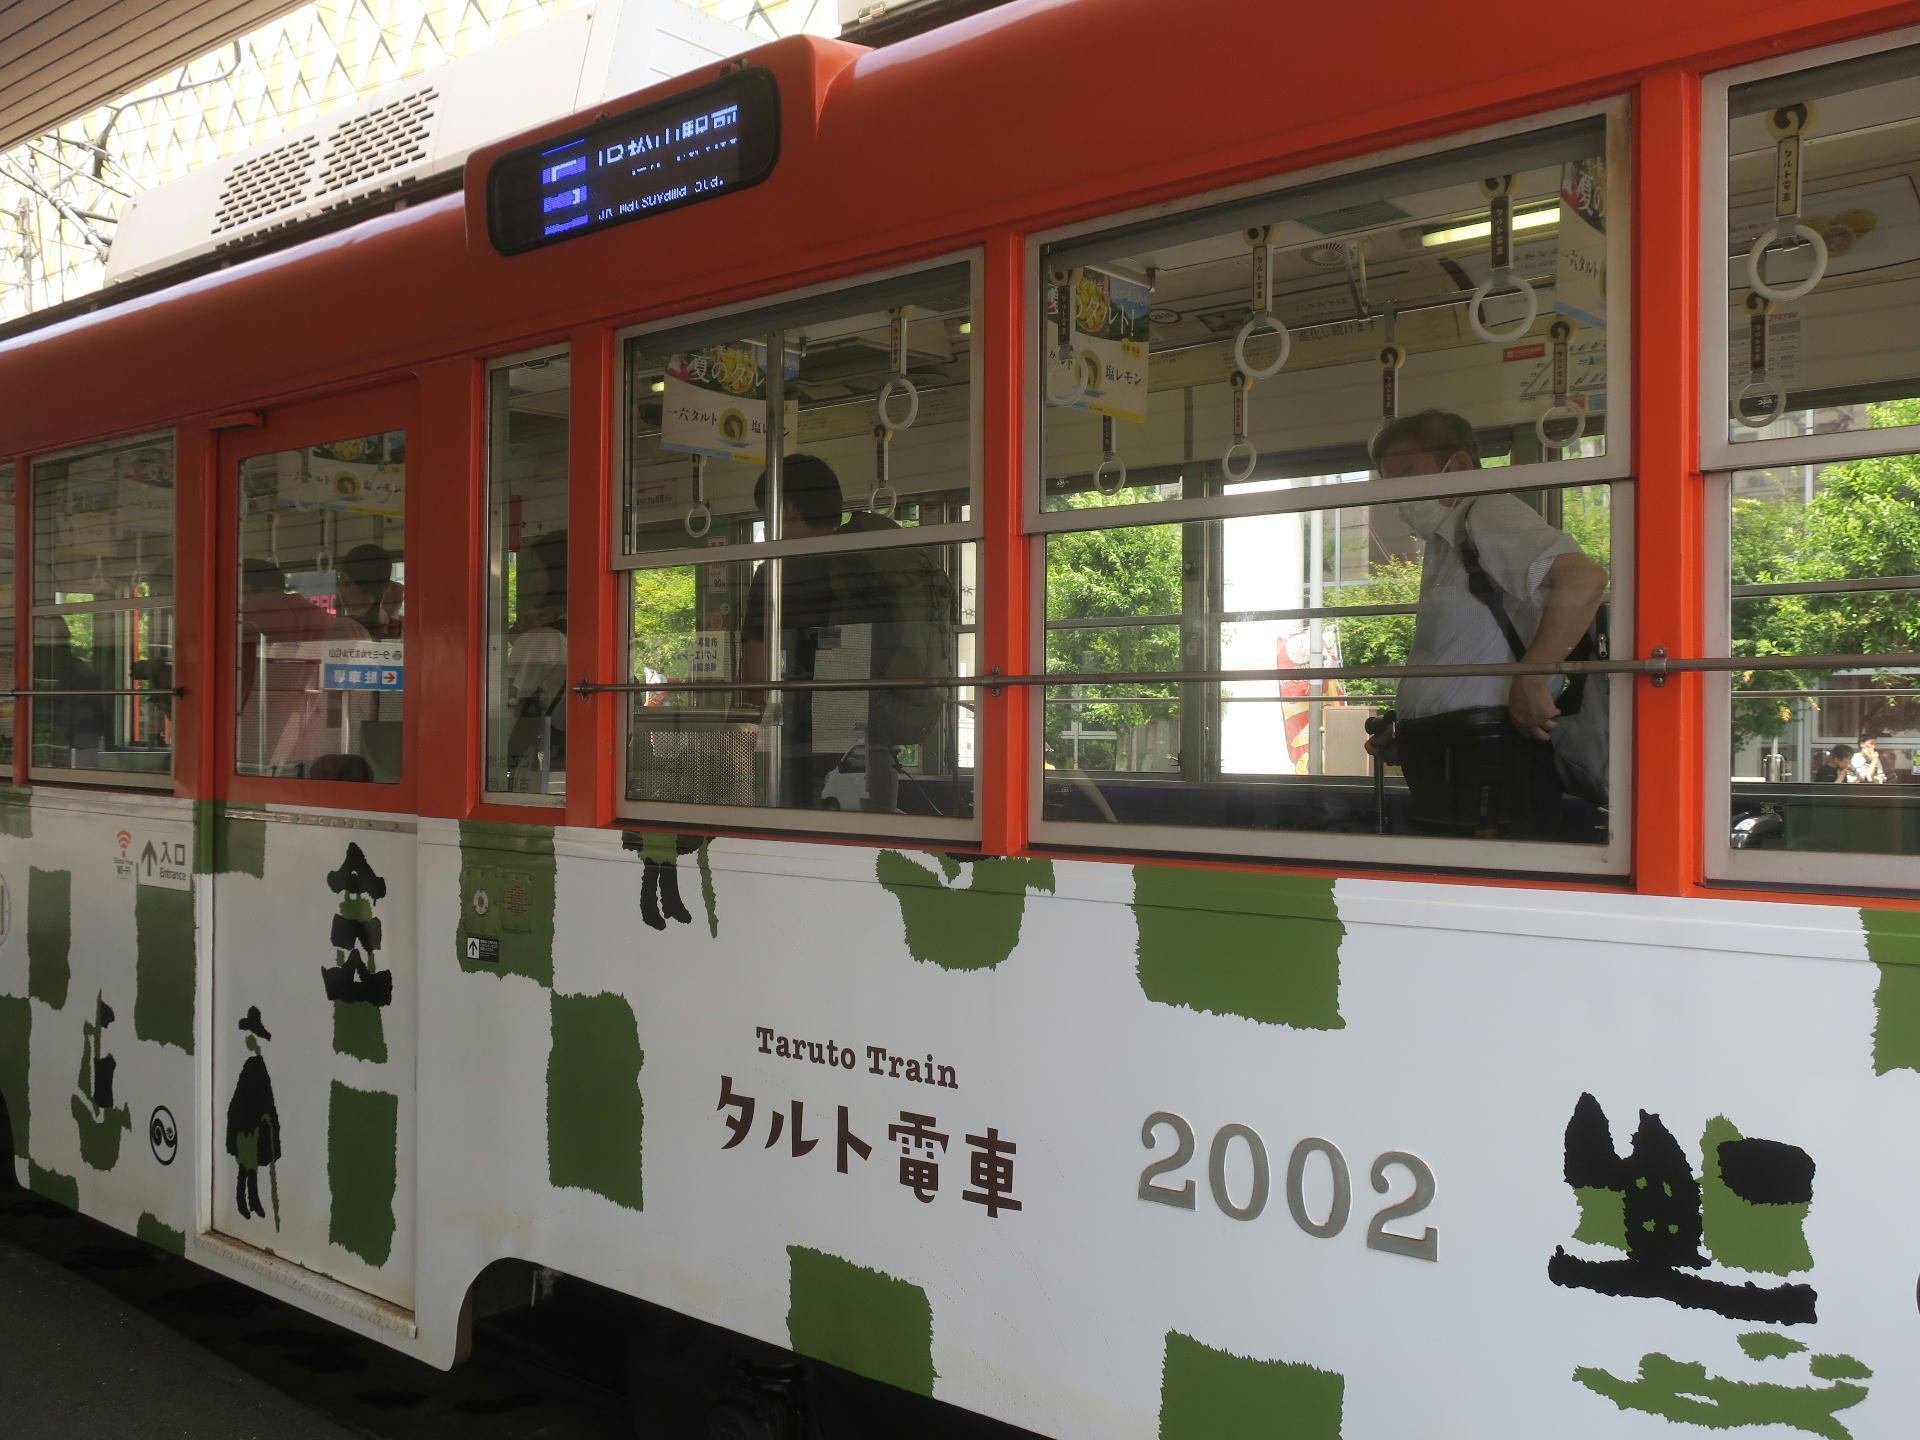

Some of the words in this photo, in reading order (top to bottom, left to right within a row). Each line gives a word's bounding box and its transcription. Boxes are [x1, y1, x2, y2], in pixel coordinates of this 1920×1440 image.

[159, 867, 187, 881] Entrance
[160, 842, 185, 866] 入口
[756, 1026, 856, 1070] Taruto
[867, 1045, 959, 1090] Train
[716, 1074, 1023, 1219] タルト電車
[1138, 1110, 1438, 1262] 2002
